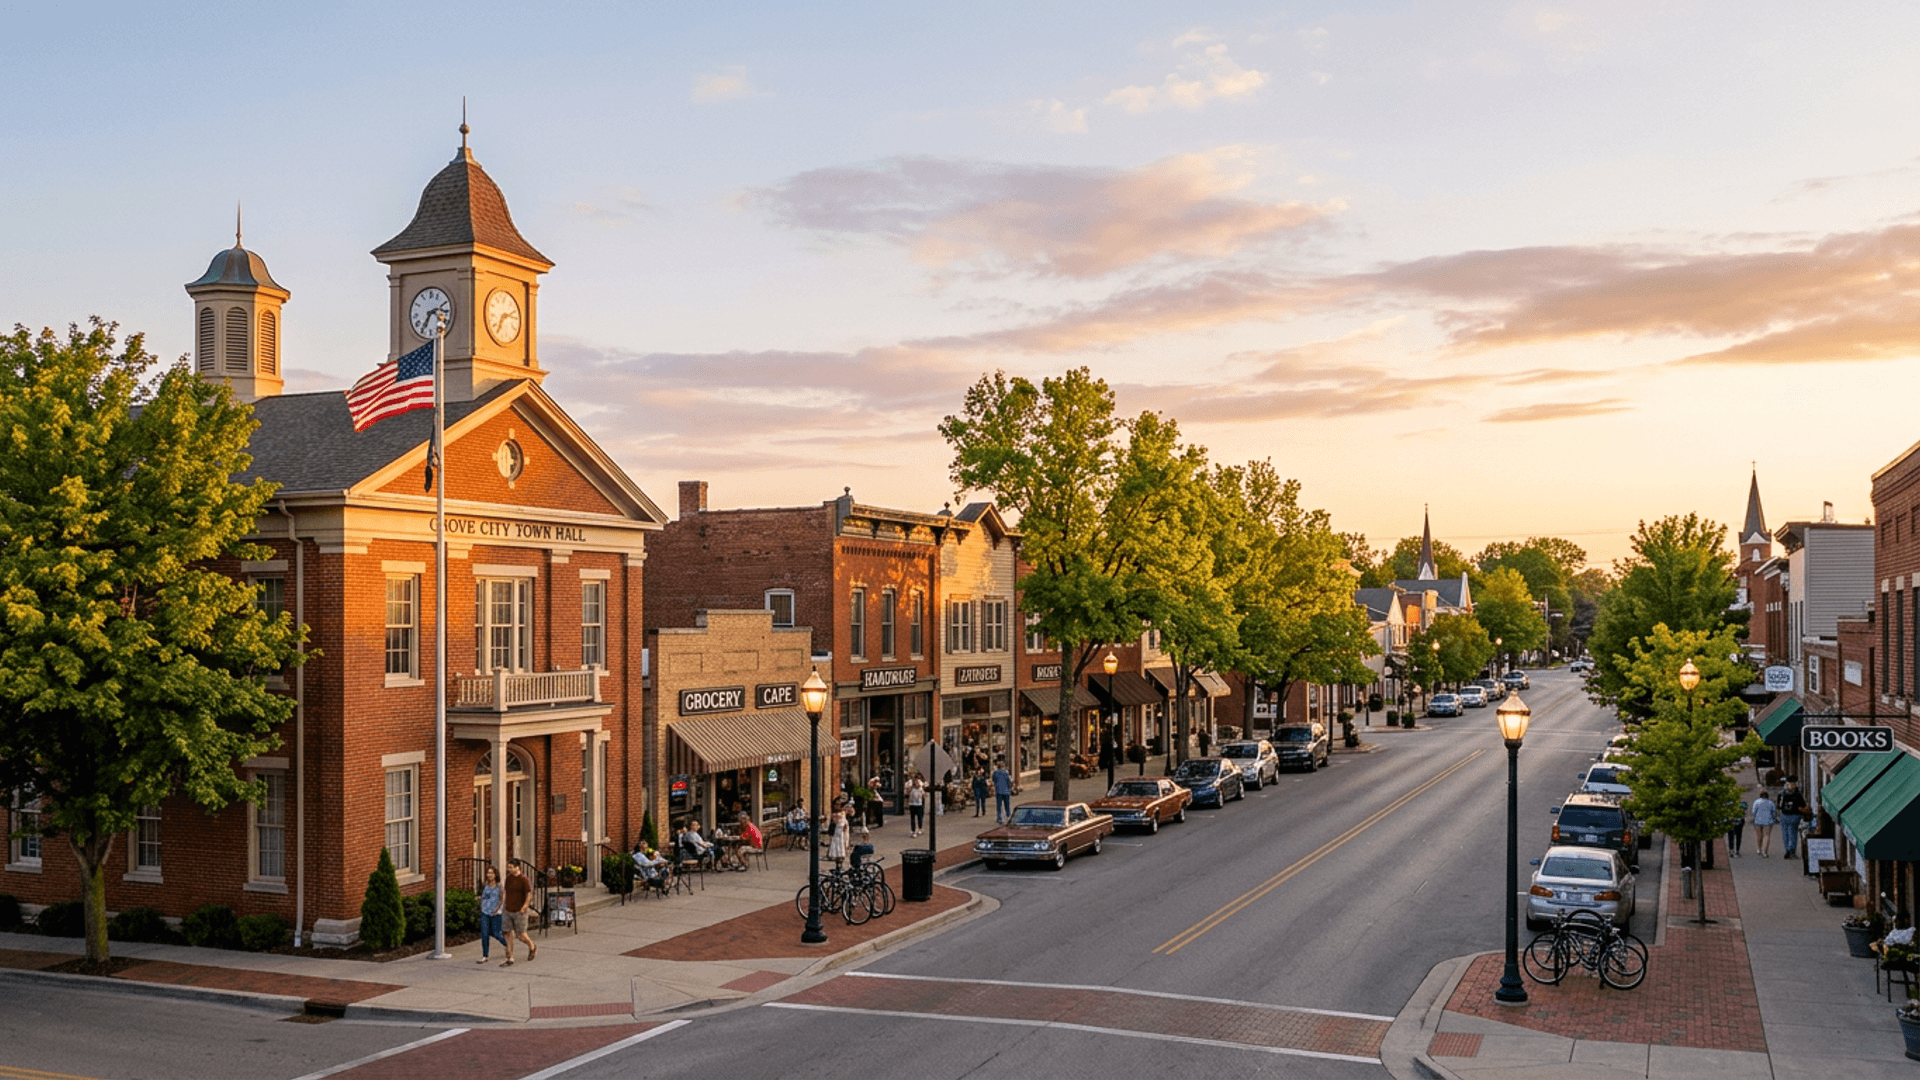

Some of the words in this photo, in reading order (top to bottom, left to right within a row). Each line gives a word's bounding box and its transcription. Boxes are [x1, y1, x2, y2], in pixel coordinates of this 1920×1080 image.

[480, 520, 510, 537] CITY
[515, 523, 552, 539] TOWN
[555, 526, 586, 542] HALL
[685, 690, 742, 710] GROCERY
[763, 686, 792, 704] CAPE
[1809, 730, 1888, 748] BOOKS
